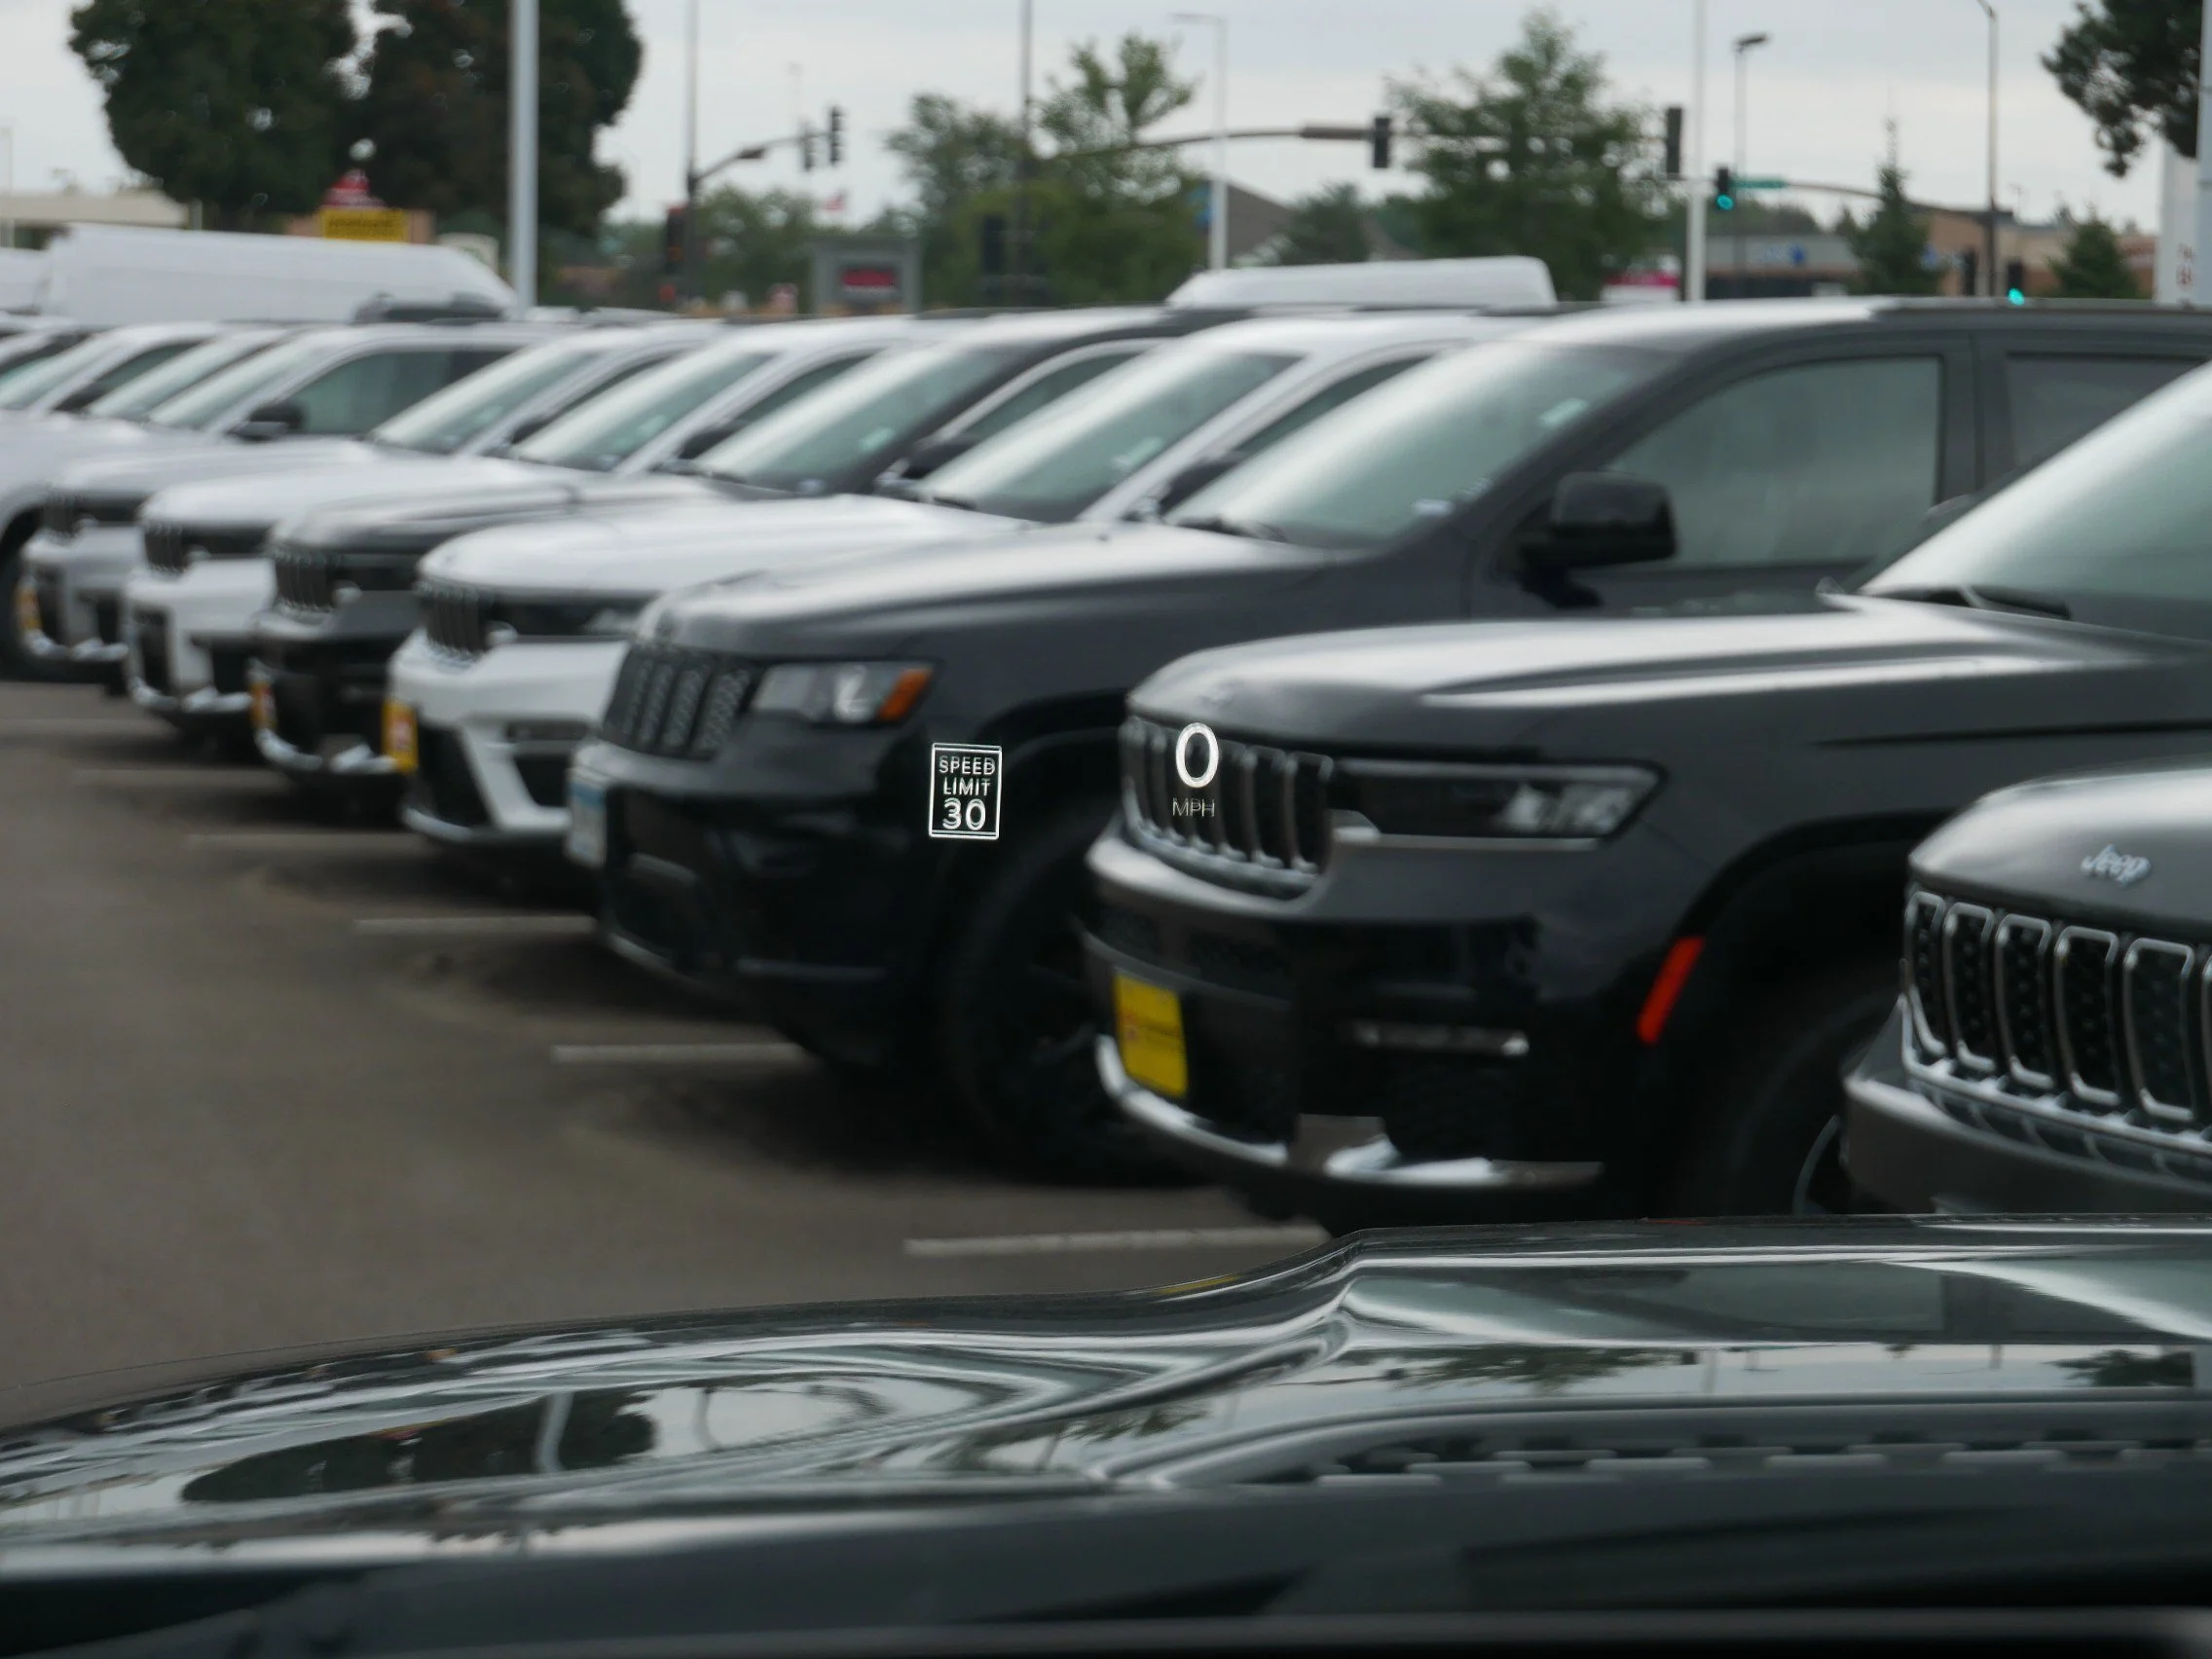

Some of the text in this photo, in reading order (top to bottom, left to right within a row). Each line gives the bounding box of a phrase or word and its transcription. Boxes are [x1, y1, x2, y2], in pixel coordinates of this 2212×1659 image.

[939, 756, 995, 775] SPEED
[1175, 722, 1219, 789] 0
[942, 777, 991, 796] LIMIT
[942, 797, 986, 830] 30
[1172, 797, 1215, 817] MPH
[2081, 845, 2152, 885] Jeep
